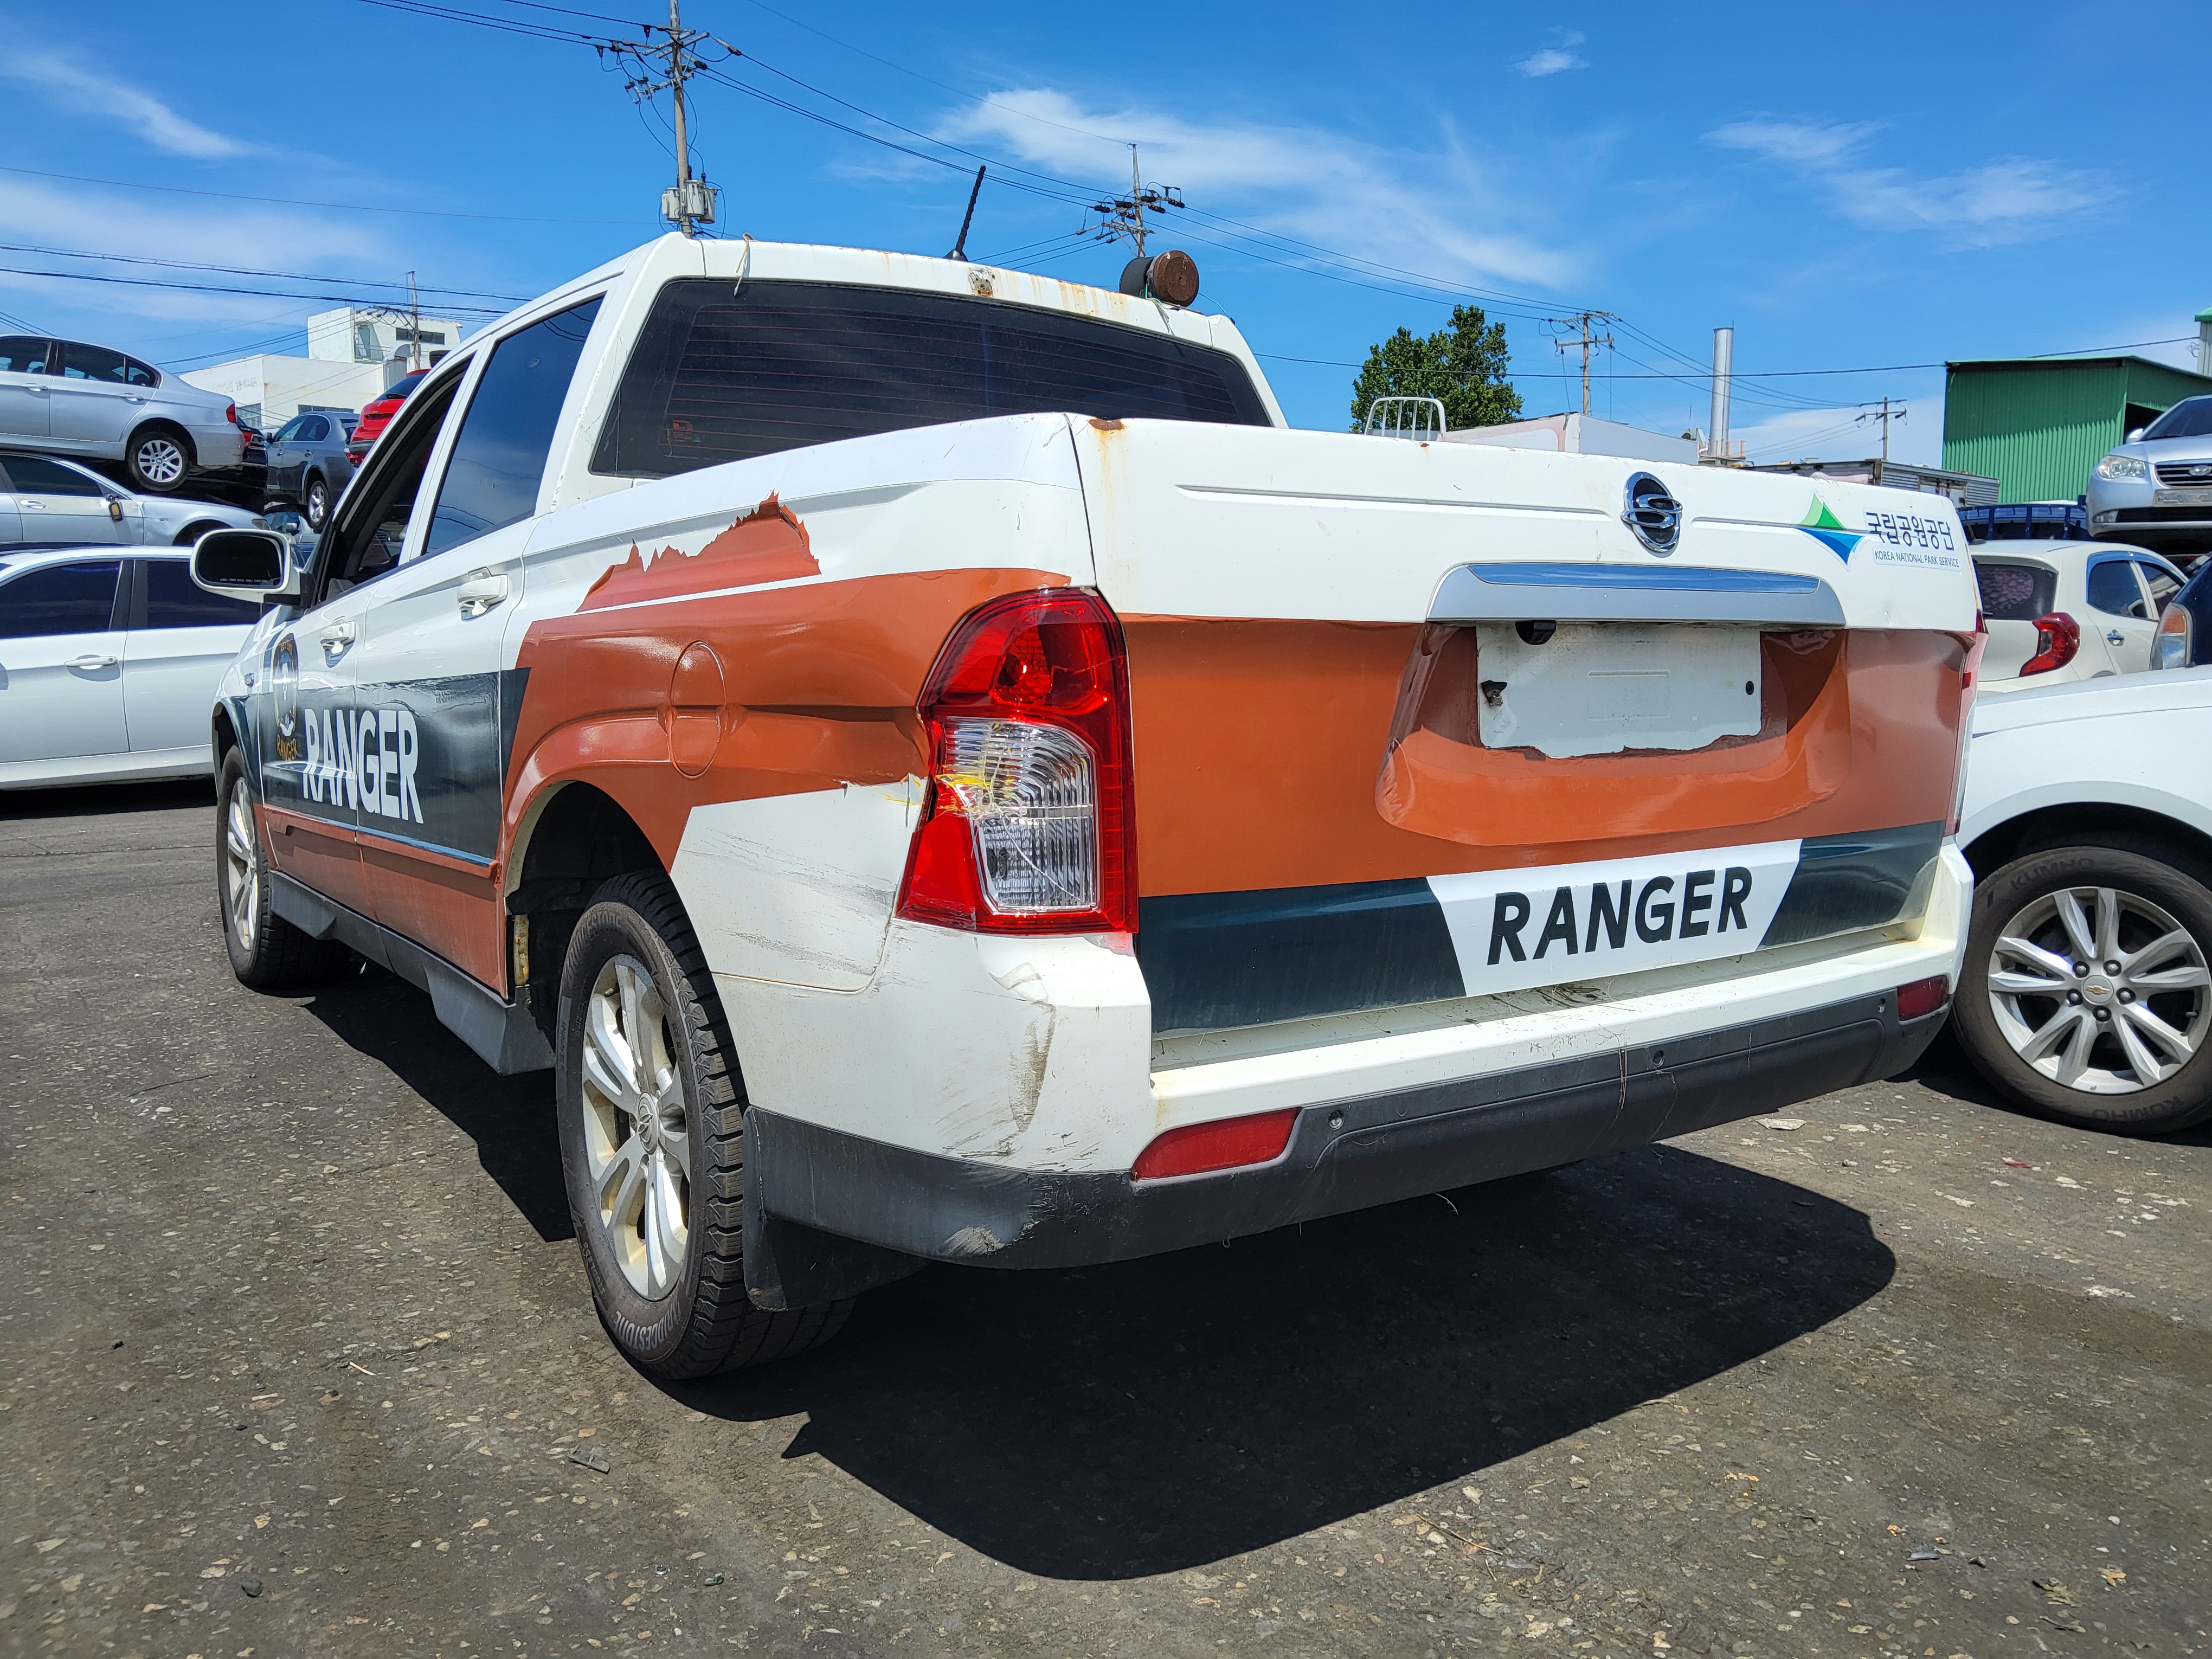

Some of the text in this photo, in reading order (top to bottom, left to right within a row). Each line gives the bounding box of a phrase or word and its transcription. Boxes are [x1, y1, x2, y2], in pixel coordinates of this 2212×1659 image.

[1866, 512, 1954, 551] 국립공원공단
[1874, 550, 1959, 568] KOREA NATIONAL PARK SERVICE
[277, 734, 298, 762] RANGER
[303, 709, 424, 824] RANGER
[2010, 858, 2094, 890] KUMHO
[1487, 866, 1752, 966] RANGER
[564, 910, 622, 991] BRIDGESTONE
[2092, 1095, 2183, 1122] KUMHO
[583, 1242, 606, 1295] STUDLESS
[614, 1294, 681, 1351] BRIDGESTONE
